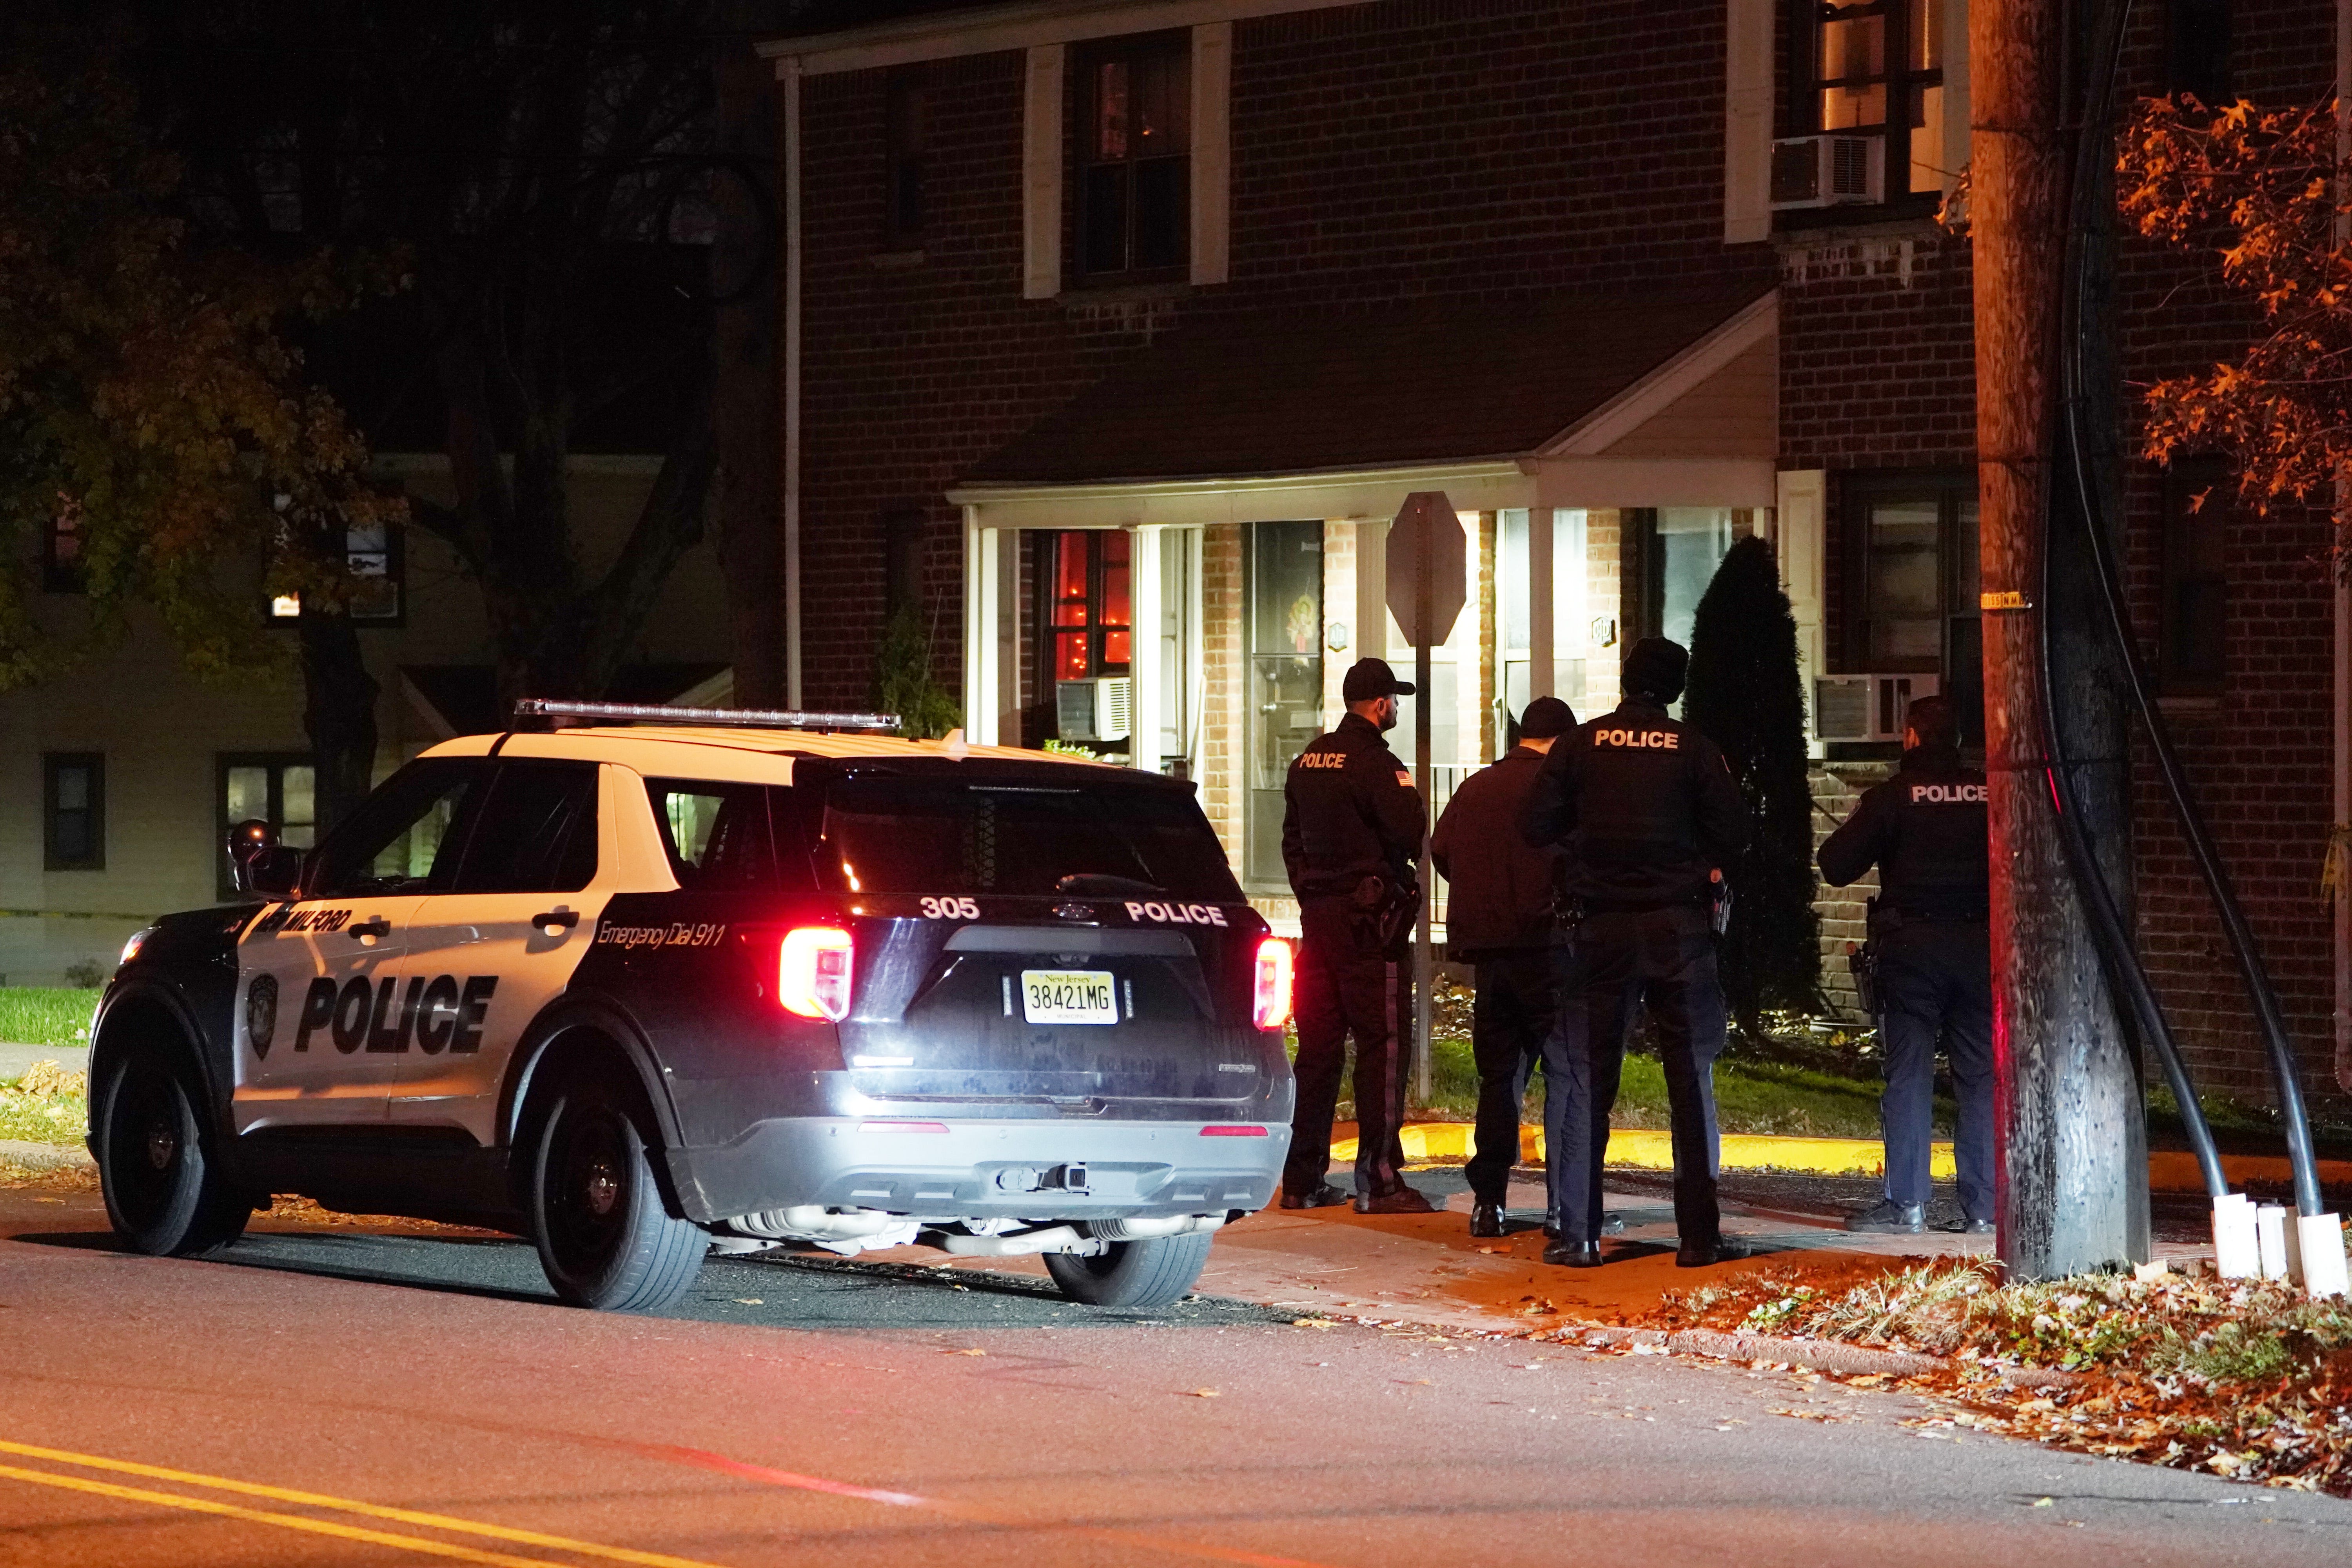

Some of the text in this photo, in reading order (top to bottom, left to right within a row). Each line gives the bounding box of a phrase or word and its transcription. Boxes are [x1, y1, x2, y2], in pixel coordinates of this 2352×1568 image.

[1595, 730, 1679, 749] POLICE
[1299, 753, 1347, 768] POLICE
[1912, 785, 1988, 802] POLICE
[920, 897, 980, 920] 305
[1124, 902, 1229, 927] POLICE
[280, 909, 352, 932] MILFORD
[598, 920, 725, 950] Emergency Dial 911
[1045, 974, 1091, 985] New Jersey
[1030, 985, 1109, 1009] 38421MG
[294, 974, 499, 1055] POLICE
